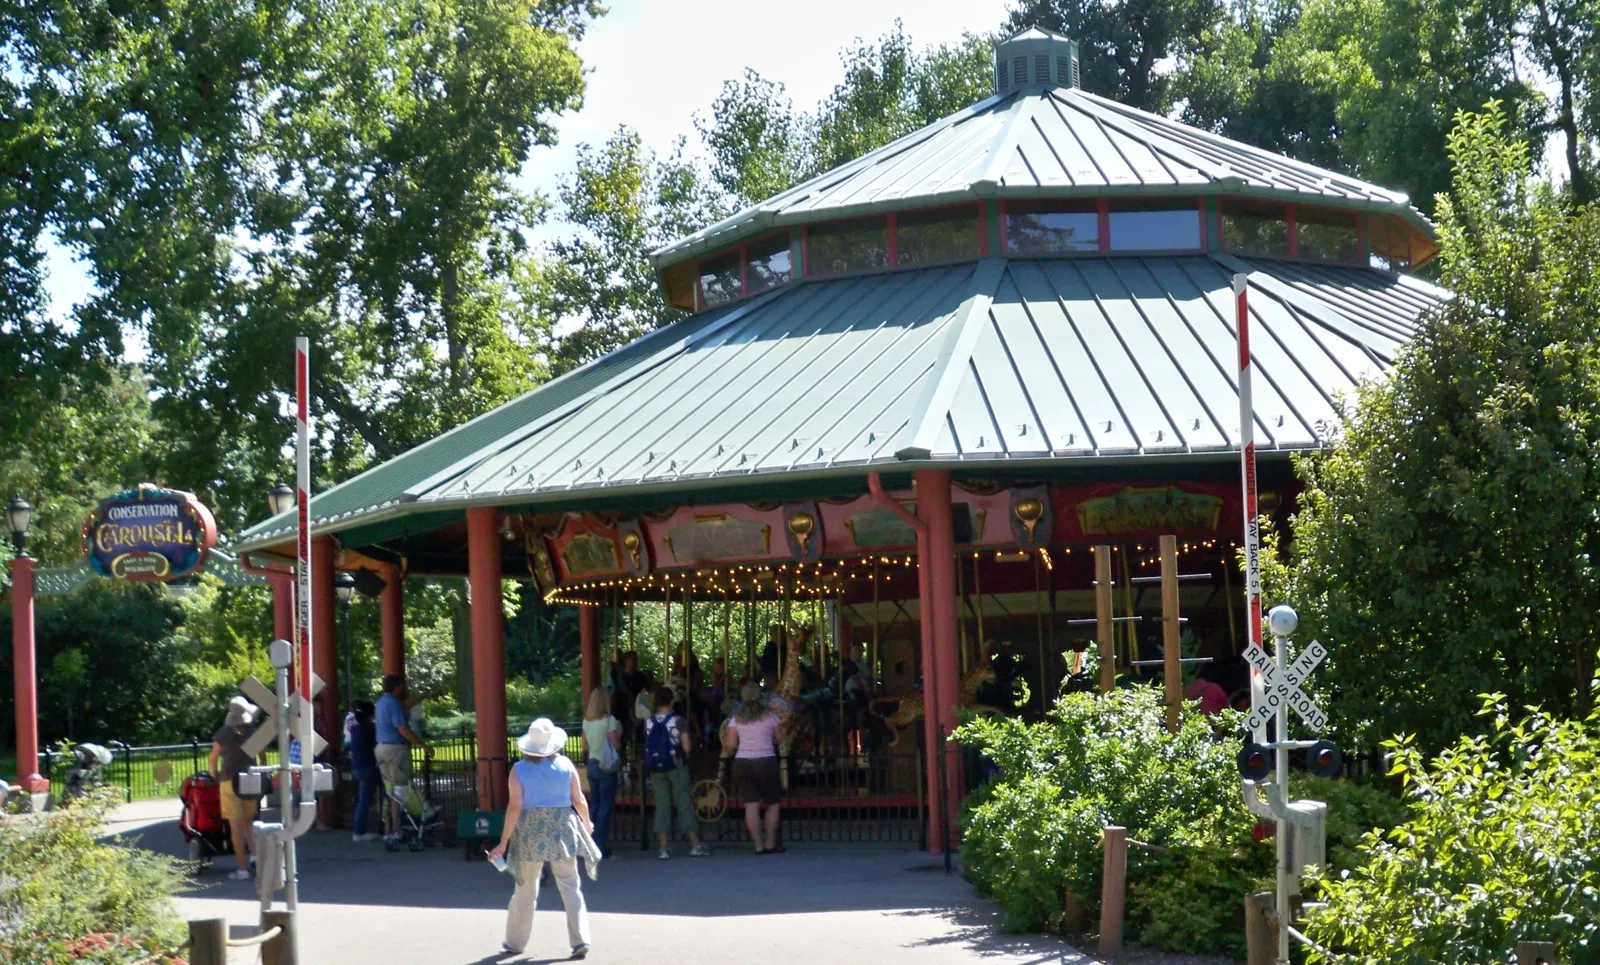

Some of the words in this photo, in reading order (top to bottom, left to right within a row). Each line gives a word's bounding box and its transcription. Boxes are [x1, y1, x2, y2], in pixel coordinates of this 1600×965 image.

[1246, 447, 1256, 496] DANGER
[108, 504, 178, 520] CONSERVATION
[1248, 512, 1258, 539] STAY
[96, 521, 193, 552] CAROUSEL
[300, 560, 308, 586] STAY
[1250, 544, 1259, 575] BACK
[1251, 593, 1260, 606] FT
[1249, 645, 1323, 729] CROSSING
